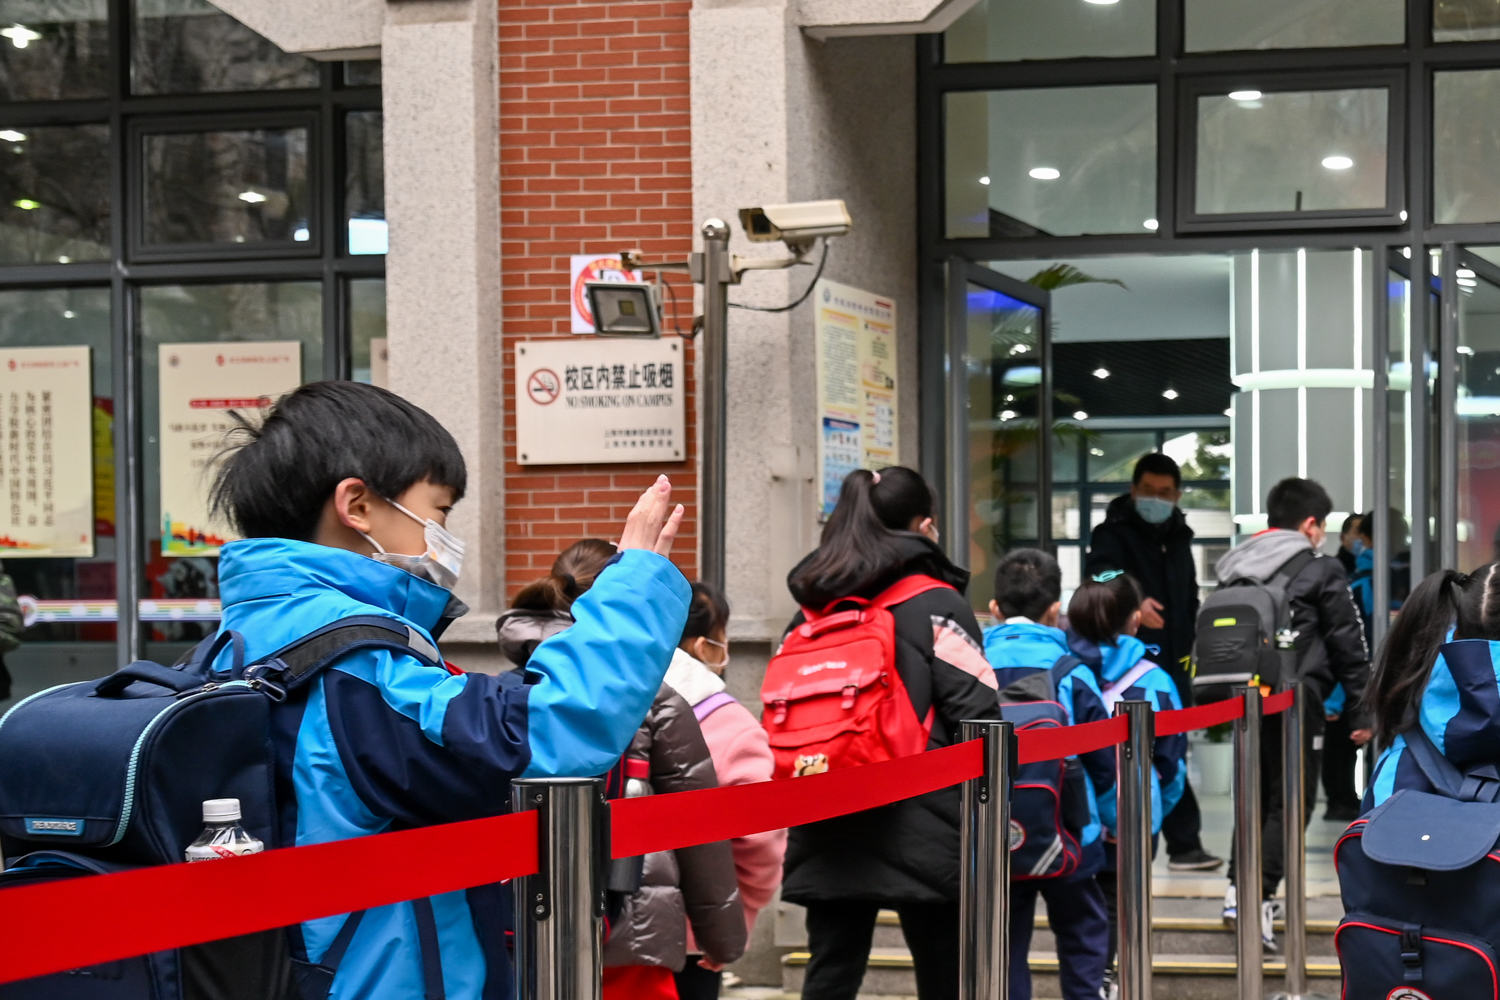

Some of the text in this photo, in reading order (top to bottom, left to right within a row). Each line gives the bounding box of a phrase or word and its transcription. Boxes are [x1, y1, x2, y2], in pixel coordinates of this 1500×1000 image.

[565, 363, 673, 391] 校区内禁止吸烟
[566, 394, 673, 408] NO SMOKING ON CAMPUS
